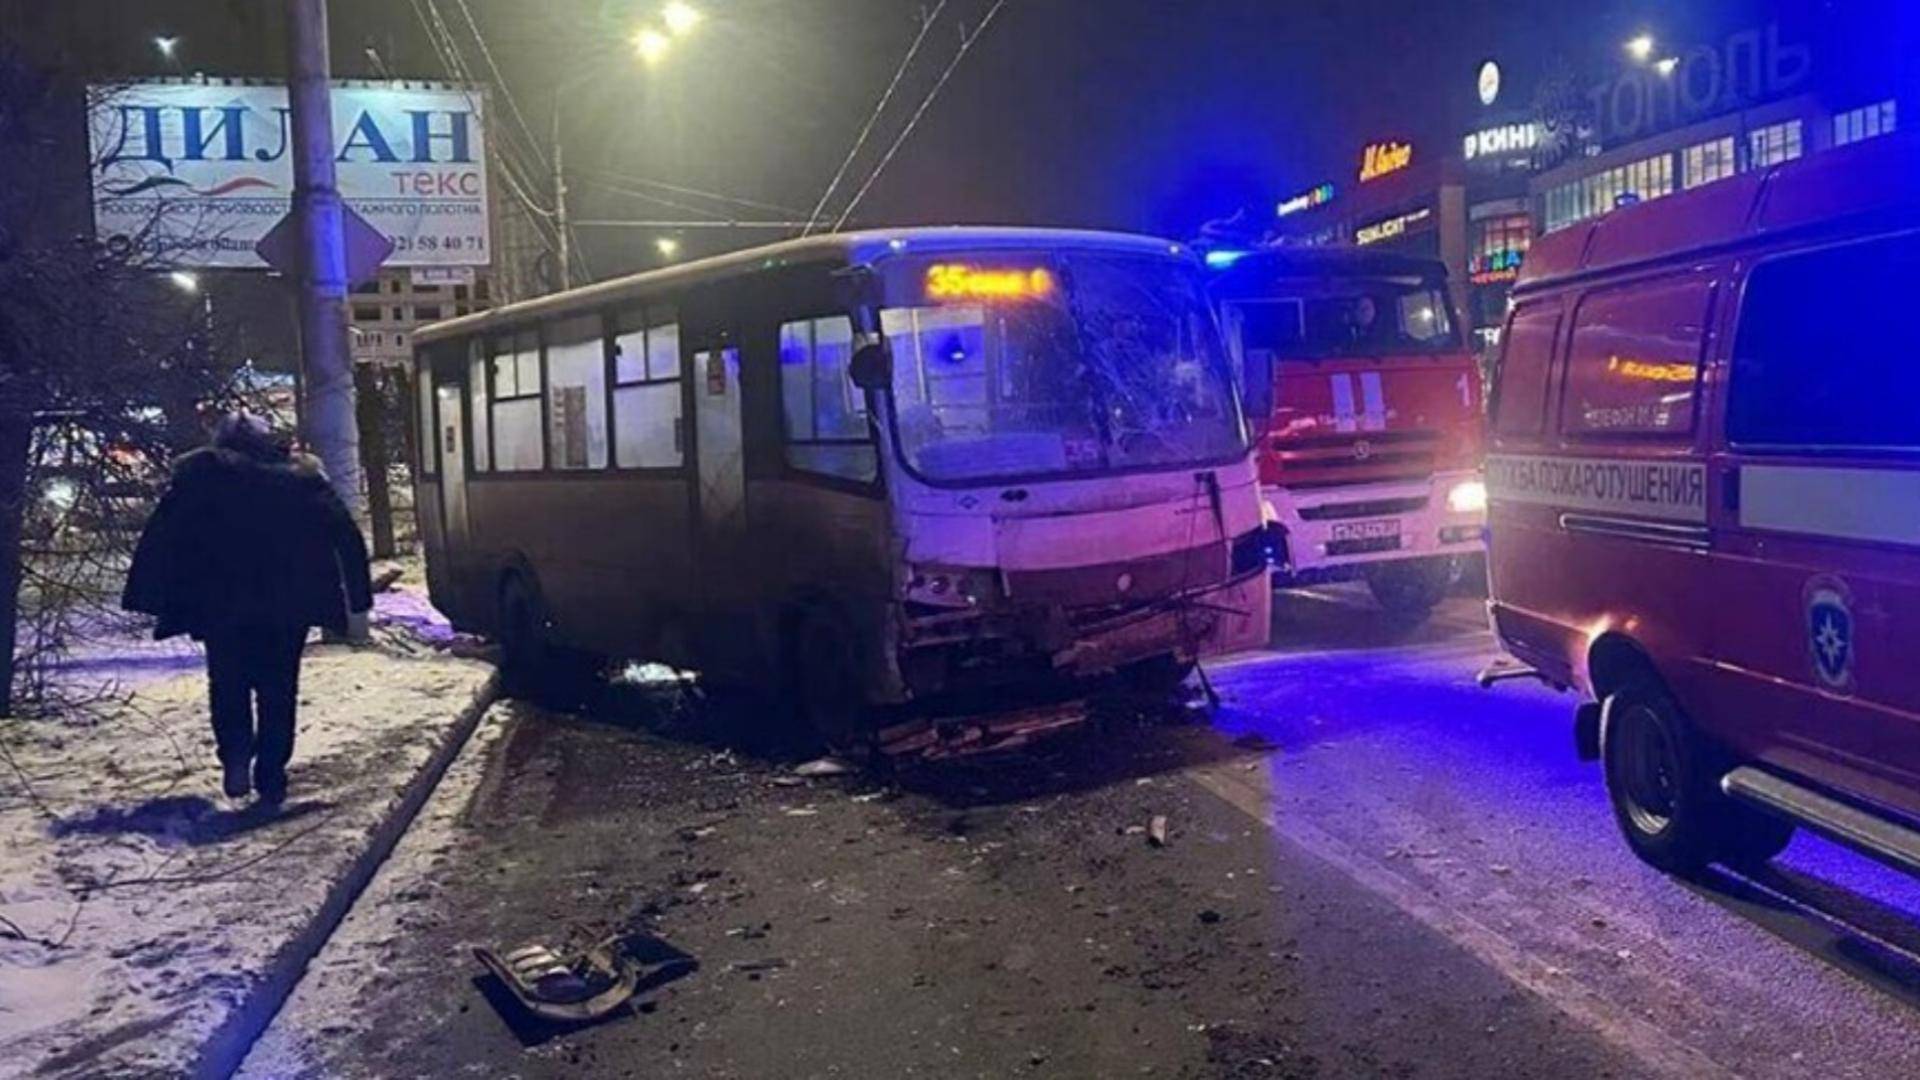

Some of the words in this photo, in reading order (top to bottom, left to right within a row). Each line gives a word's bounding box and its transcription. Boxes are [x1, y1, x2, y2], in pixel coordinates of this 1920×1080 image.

[1589, 24, 1812, 135] ТОПОЛЬ
[391, 171, 480, 196] текс
[418, 235, 438, 251] 58
[442, 236, 461, 250] 40
[465, 236, 484, 250] 71
[1457, 373, 1470, 407] 1
[1540, 461, 1703, 505] ПОЖАРОТУШЕНИЯ
